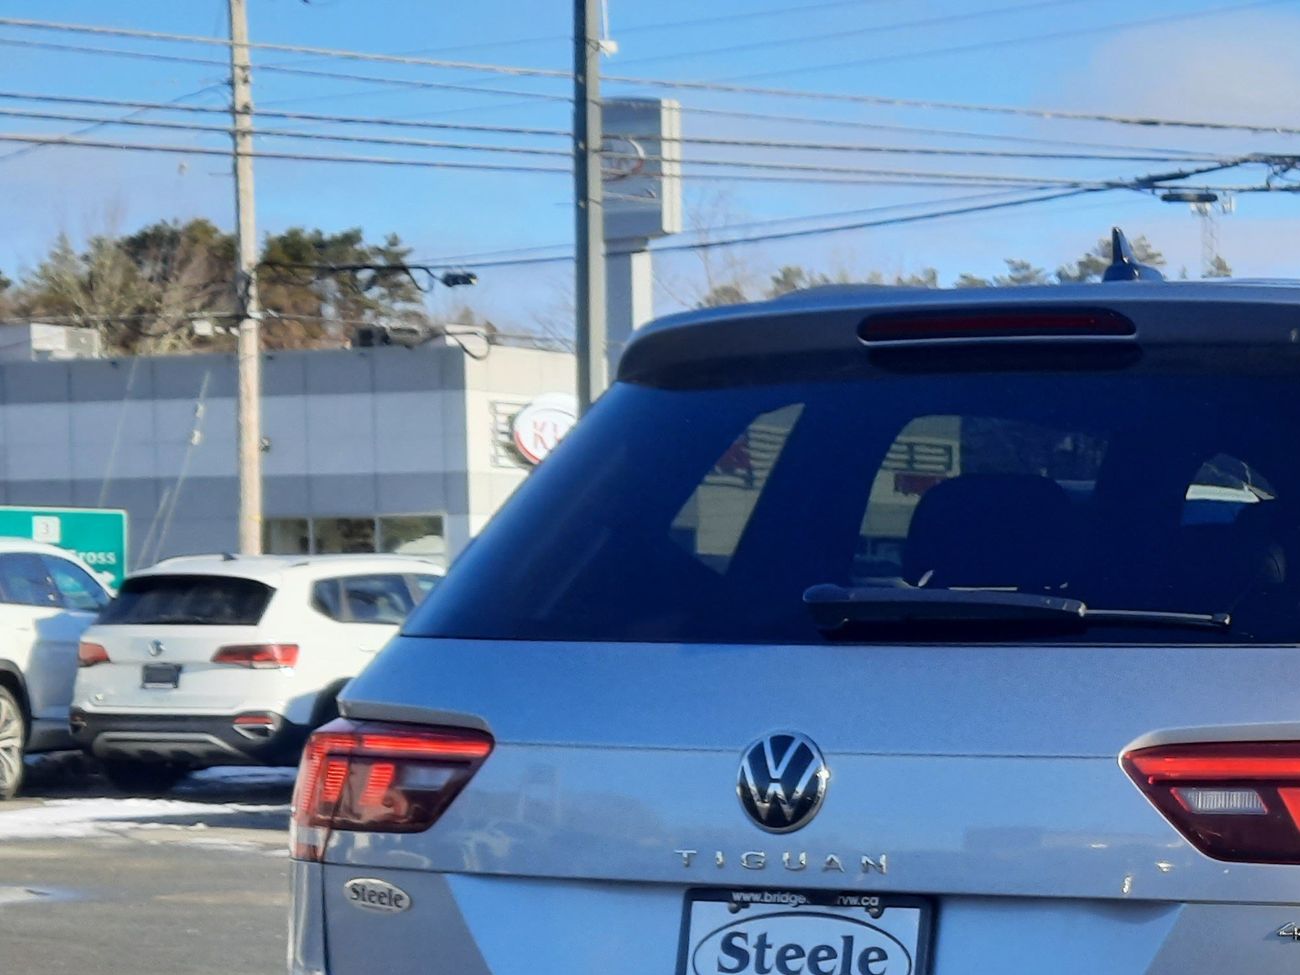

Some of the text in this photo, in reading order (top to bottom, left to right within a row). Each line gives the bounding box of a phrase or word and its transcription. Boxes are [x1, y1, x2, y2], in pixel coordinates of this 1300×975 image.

[66, 549, 116, 566] ross
[736, 729, 828, 834] VW
[674, 849, 888, 874] TIGUAN
[350, 882, 404, 909] Steele
